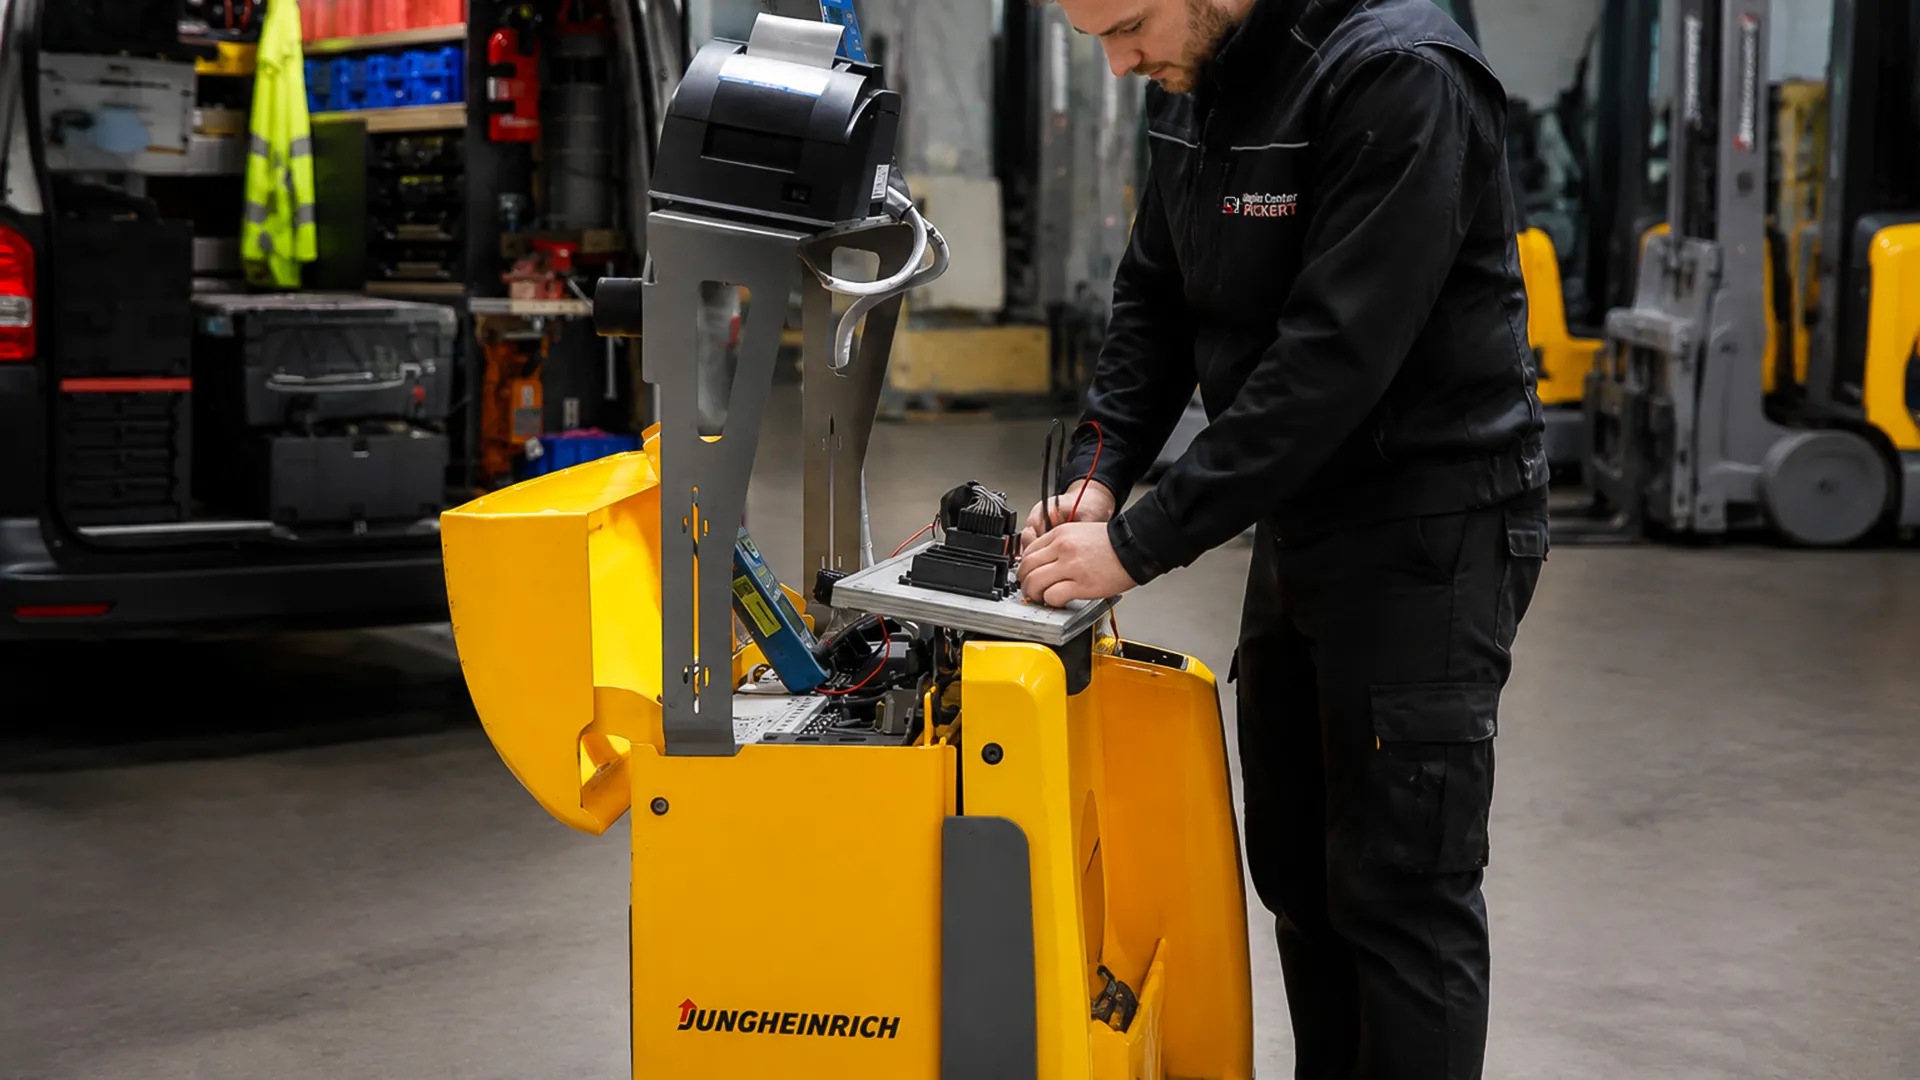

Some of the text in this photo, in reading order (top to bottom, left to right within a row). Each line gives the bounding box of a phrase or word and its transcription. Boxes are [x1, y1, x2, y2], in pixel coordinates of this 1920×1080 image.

[1265, 192, 1298, 204] Center
[1243, 203, 1297, 217] PICKERT
[677, 1009, 900, 1040] JUNGHEINRICH
